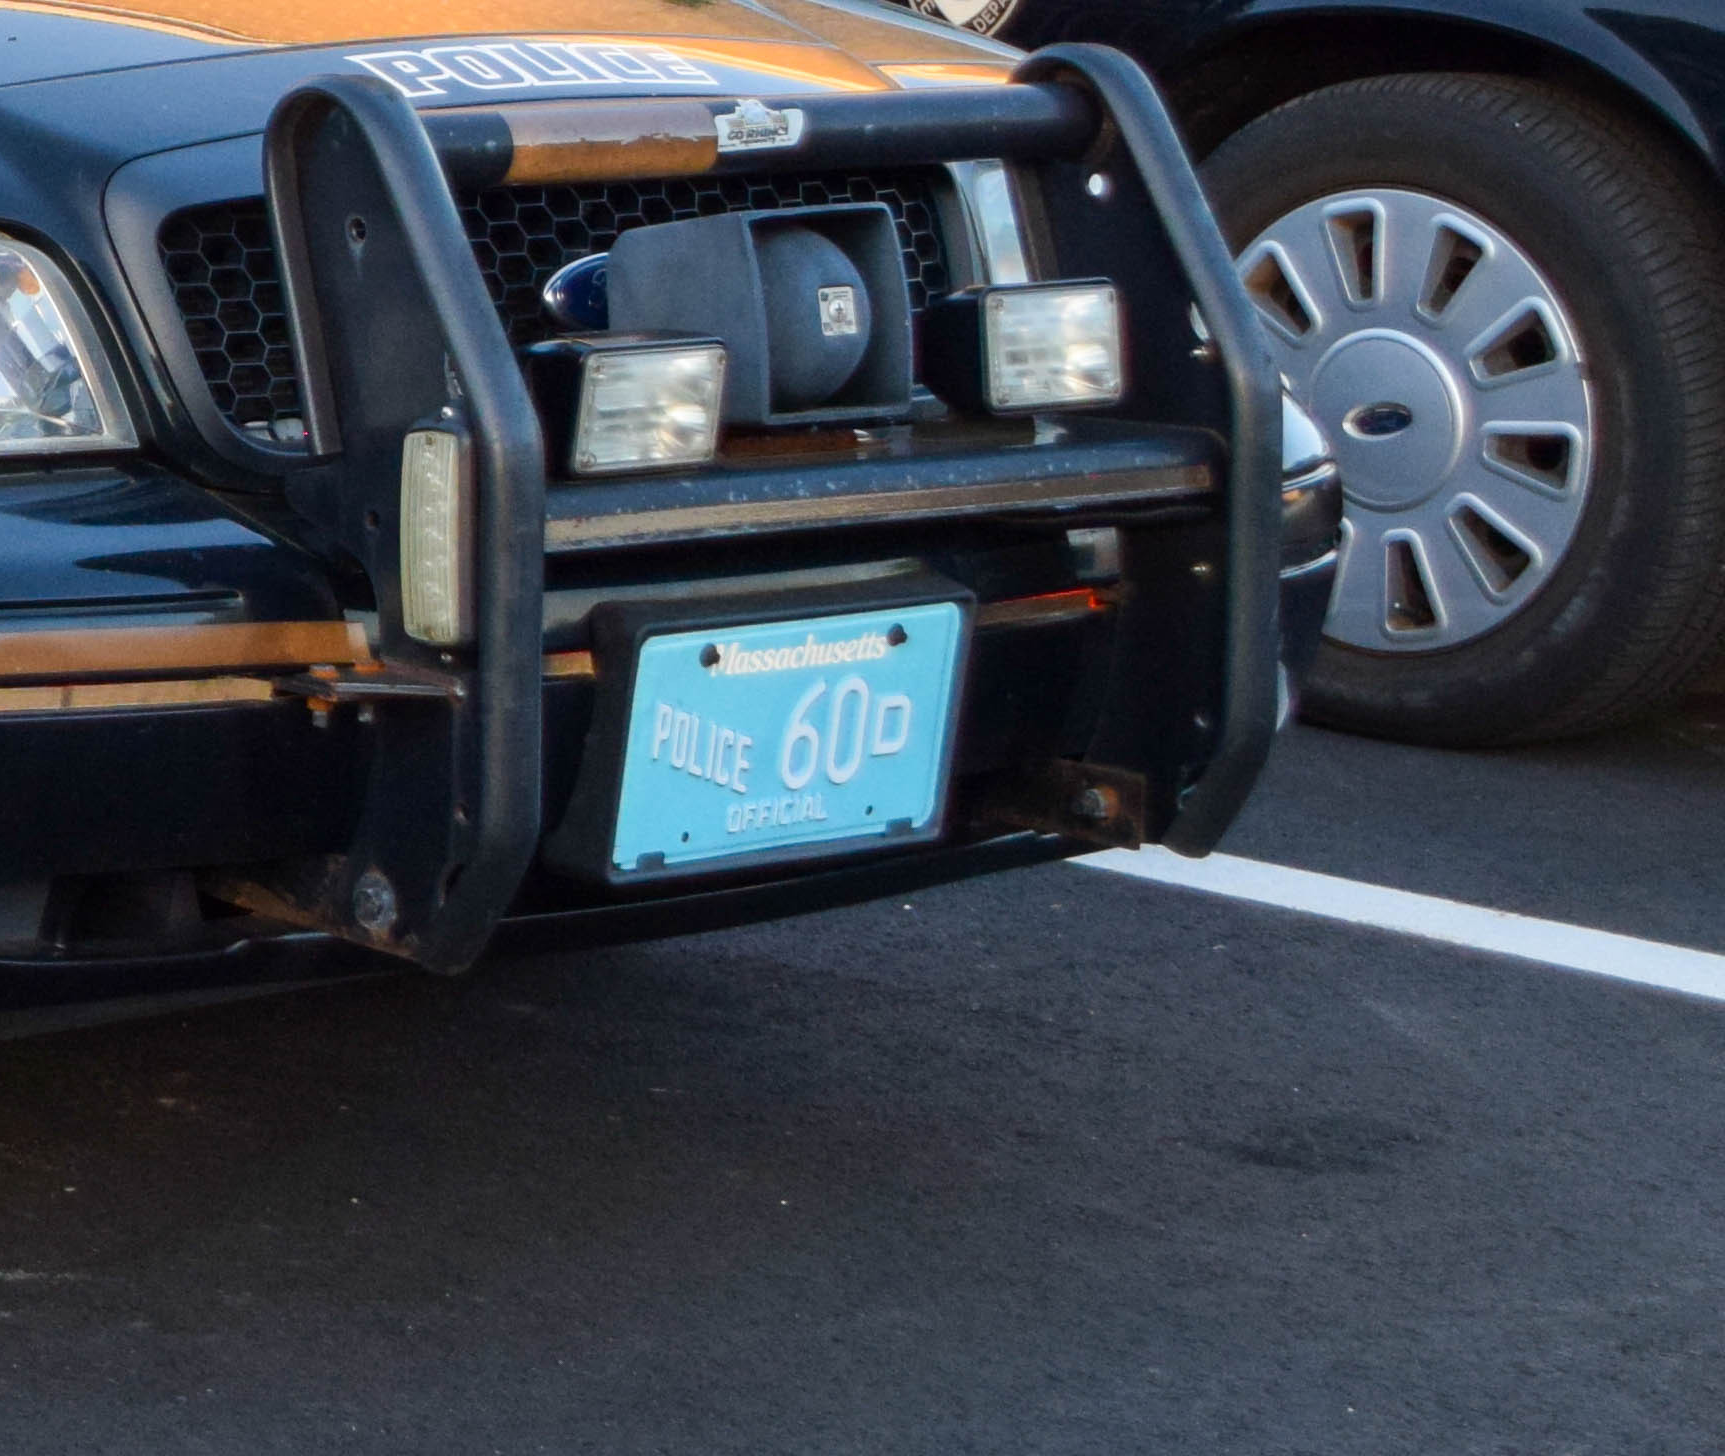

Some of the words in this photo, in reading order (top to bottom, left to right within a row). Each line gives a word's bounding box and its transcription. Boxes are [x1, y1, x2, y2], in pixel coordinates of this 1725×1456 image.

[343, 42, 720, 99] POLICE
[709, 631, 888, 678] Massachusetts
[652, 702, 753, 795] POLICE
[725, 792, 829, 835] OFFICIAL
